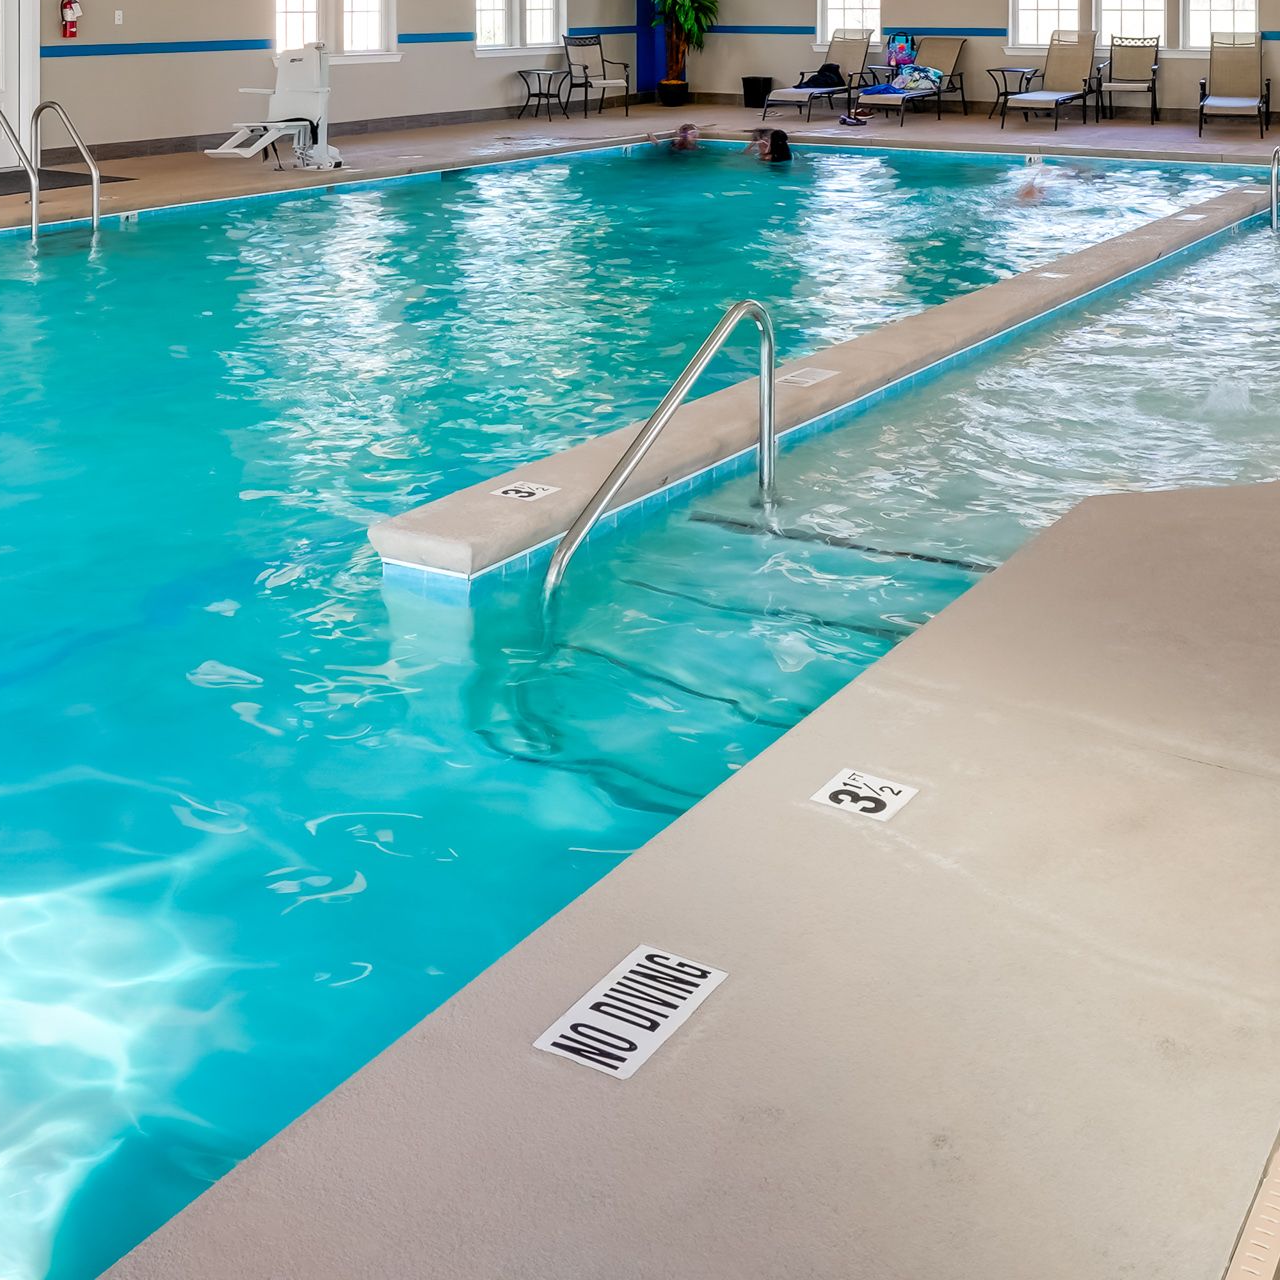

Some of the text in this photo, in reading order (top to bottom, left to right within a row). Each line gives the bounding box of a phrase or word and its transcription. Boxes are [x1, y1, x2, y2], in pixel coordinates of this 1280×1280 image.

[501, 488, 536, 498] 3
[828, 789, 887, 814] 3
[550, 953, 712, 1070] NO DIVING
